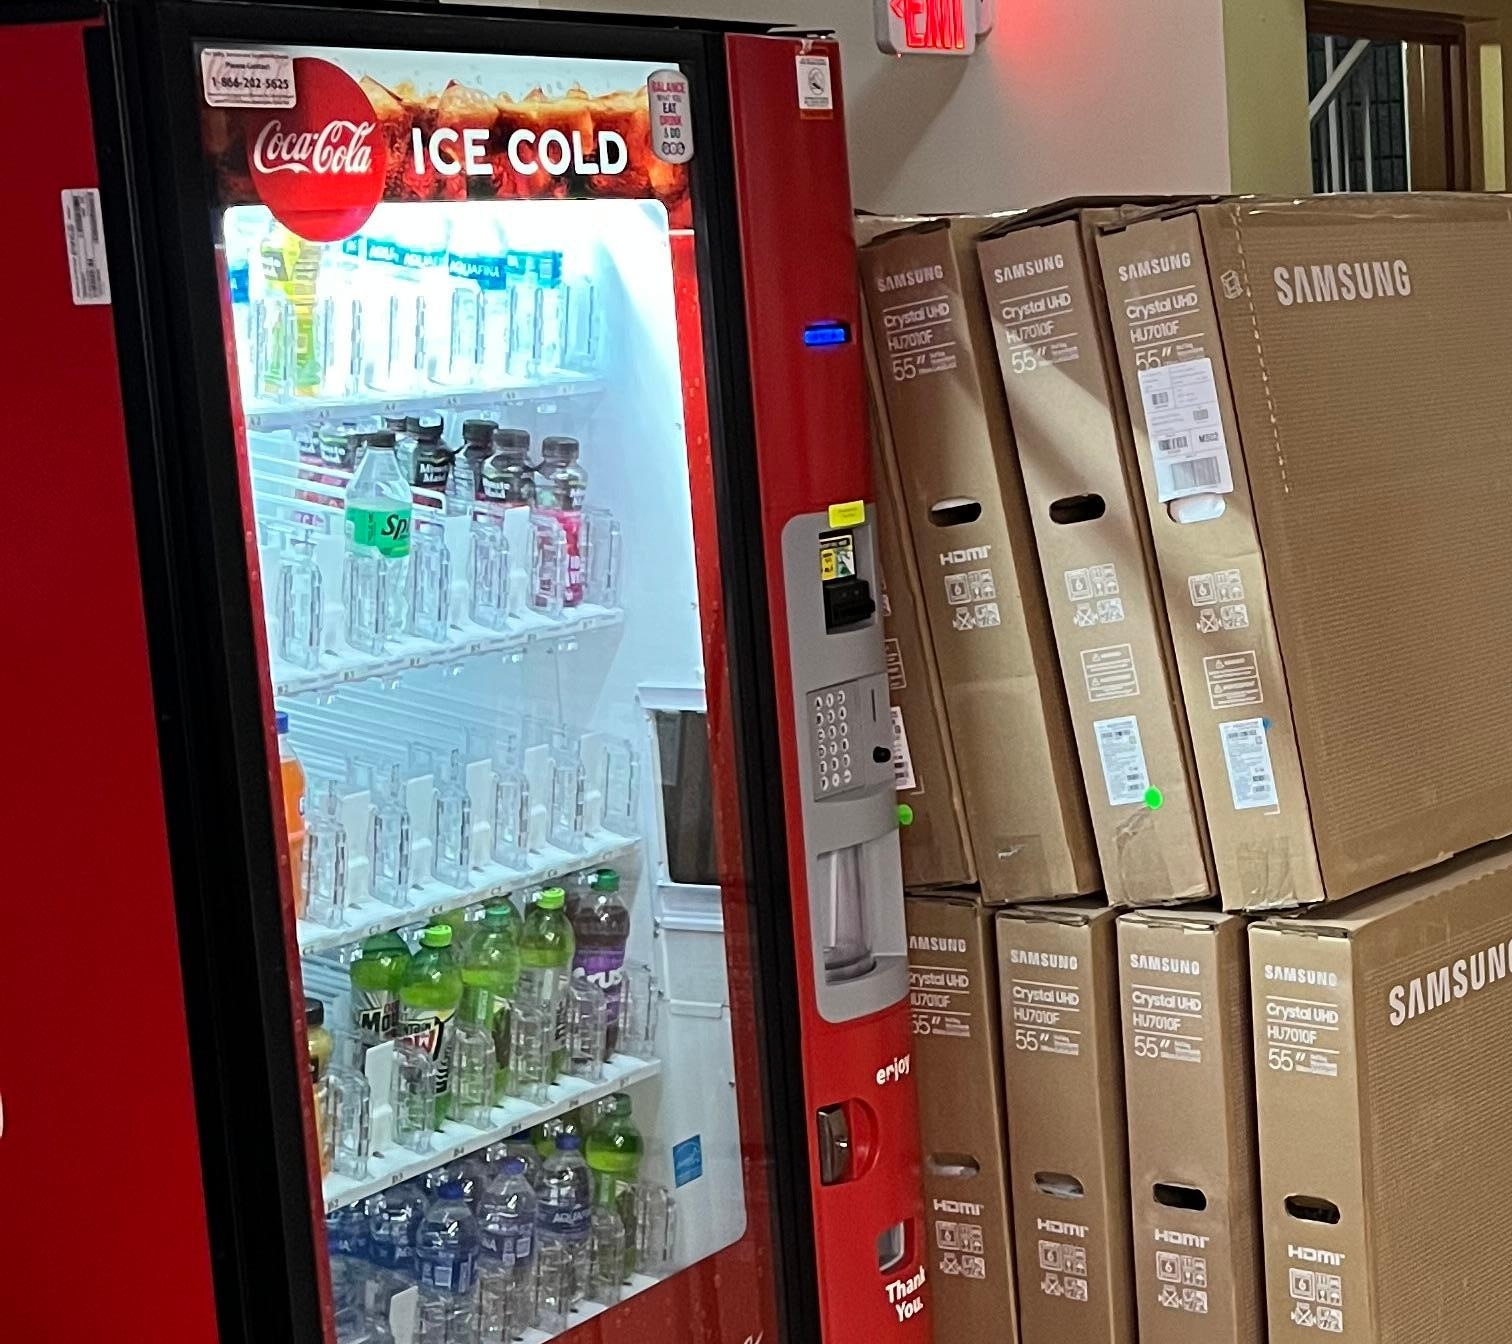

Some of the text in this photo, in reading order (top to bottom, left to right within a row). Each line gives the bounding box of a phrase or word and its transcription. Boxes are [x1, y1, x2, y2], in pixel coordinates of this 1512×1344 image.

[663, 103, 677, 113] EAT
[253, 119, 376, 174] Coca-Cola
[411, 127, 628, 177] ICE COLD
[994, 254, 1064, 284] SAMSUNG
[1118, 252, 1191, 282] SAMSUNG
[877, 264, 944, 293] SAMSUNG
[1273, 259, 1411, 306] SAMSUNG
[884, 302, 950, 329] Crystal UHD
[1002, 293, 1071, 320] Crystal UHD
[1126, 292, 1198, 322] Crystal UHD
[888, 330, 933, 351] HU7010F
[1005, 320, 1055, 344] HU7010F
[1130, 319, 1180, 344] HU7010F
[940, 545, 991, 566] HDMI
[909, 935, 967, 953] AMSUNG
[1010, 949, 1078, 971] SAMSUNG
[1130, 953, 1200, 976] SAMSUNG
[946, 974, 970, 988] UHD
[1264, 964, 1338, 987] SAMSUNG
[1012, 986, 1080, 1006] Crystal UHD
[1131, 990, 1202, 1012] Crystal UHD
[1013, 1007, 1060, 1025] HU7010F
[1132, 1011, 1182, 1031] HU7010F
[1266, 1002, 1339, 1024] Crystal UHD
[1267, 1024, 1317, 1045] HU7010F
[933, 1198, 985, 1216] HDMI
[1037, 1217, 1090, 1238] HDMI
[1154, 1228, 1210, 1249] HDMI
[1287, 1244, 1346, 1266] HDMI
[886, 1266, 925, 1304] Thank
